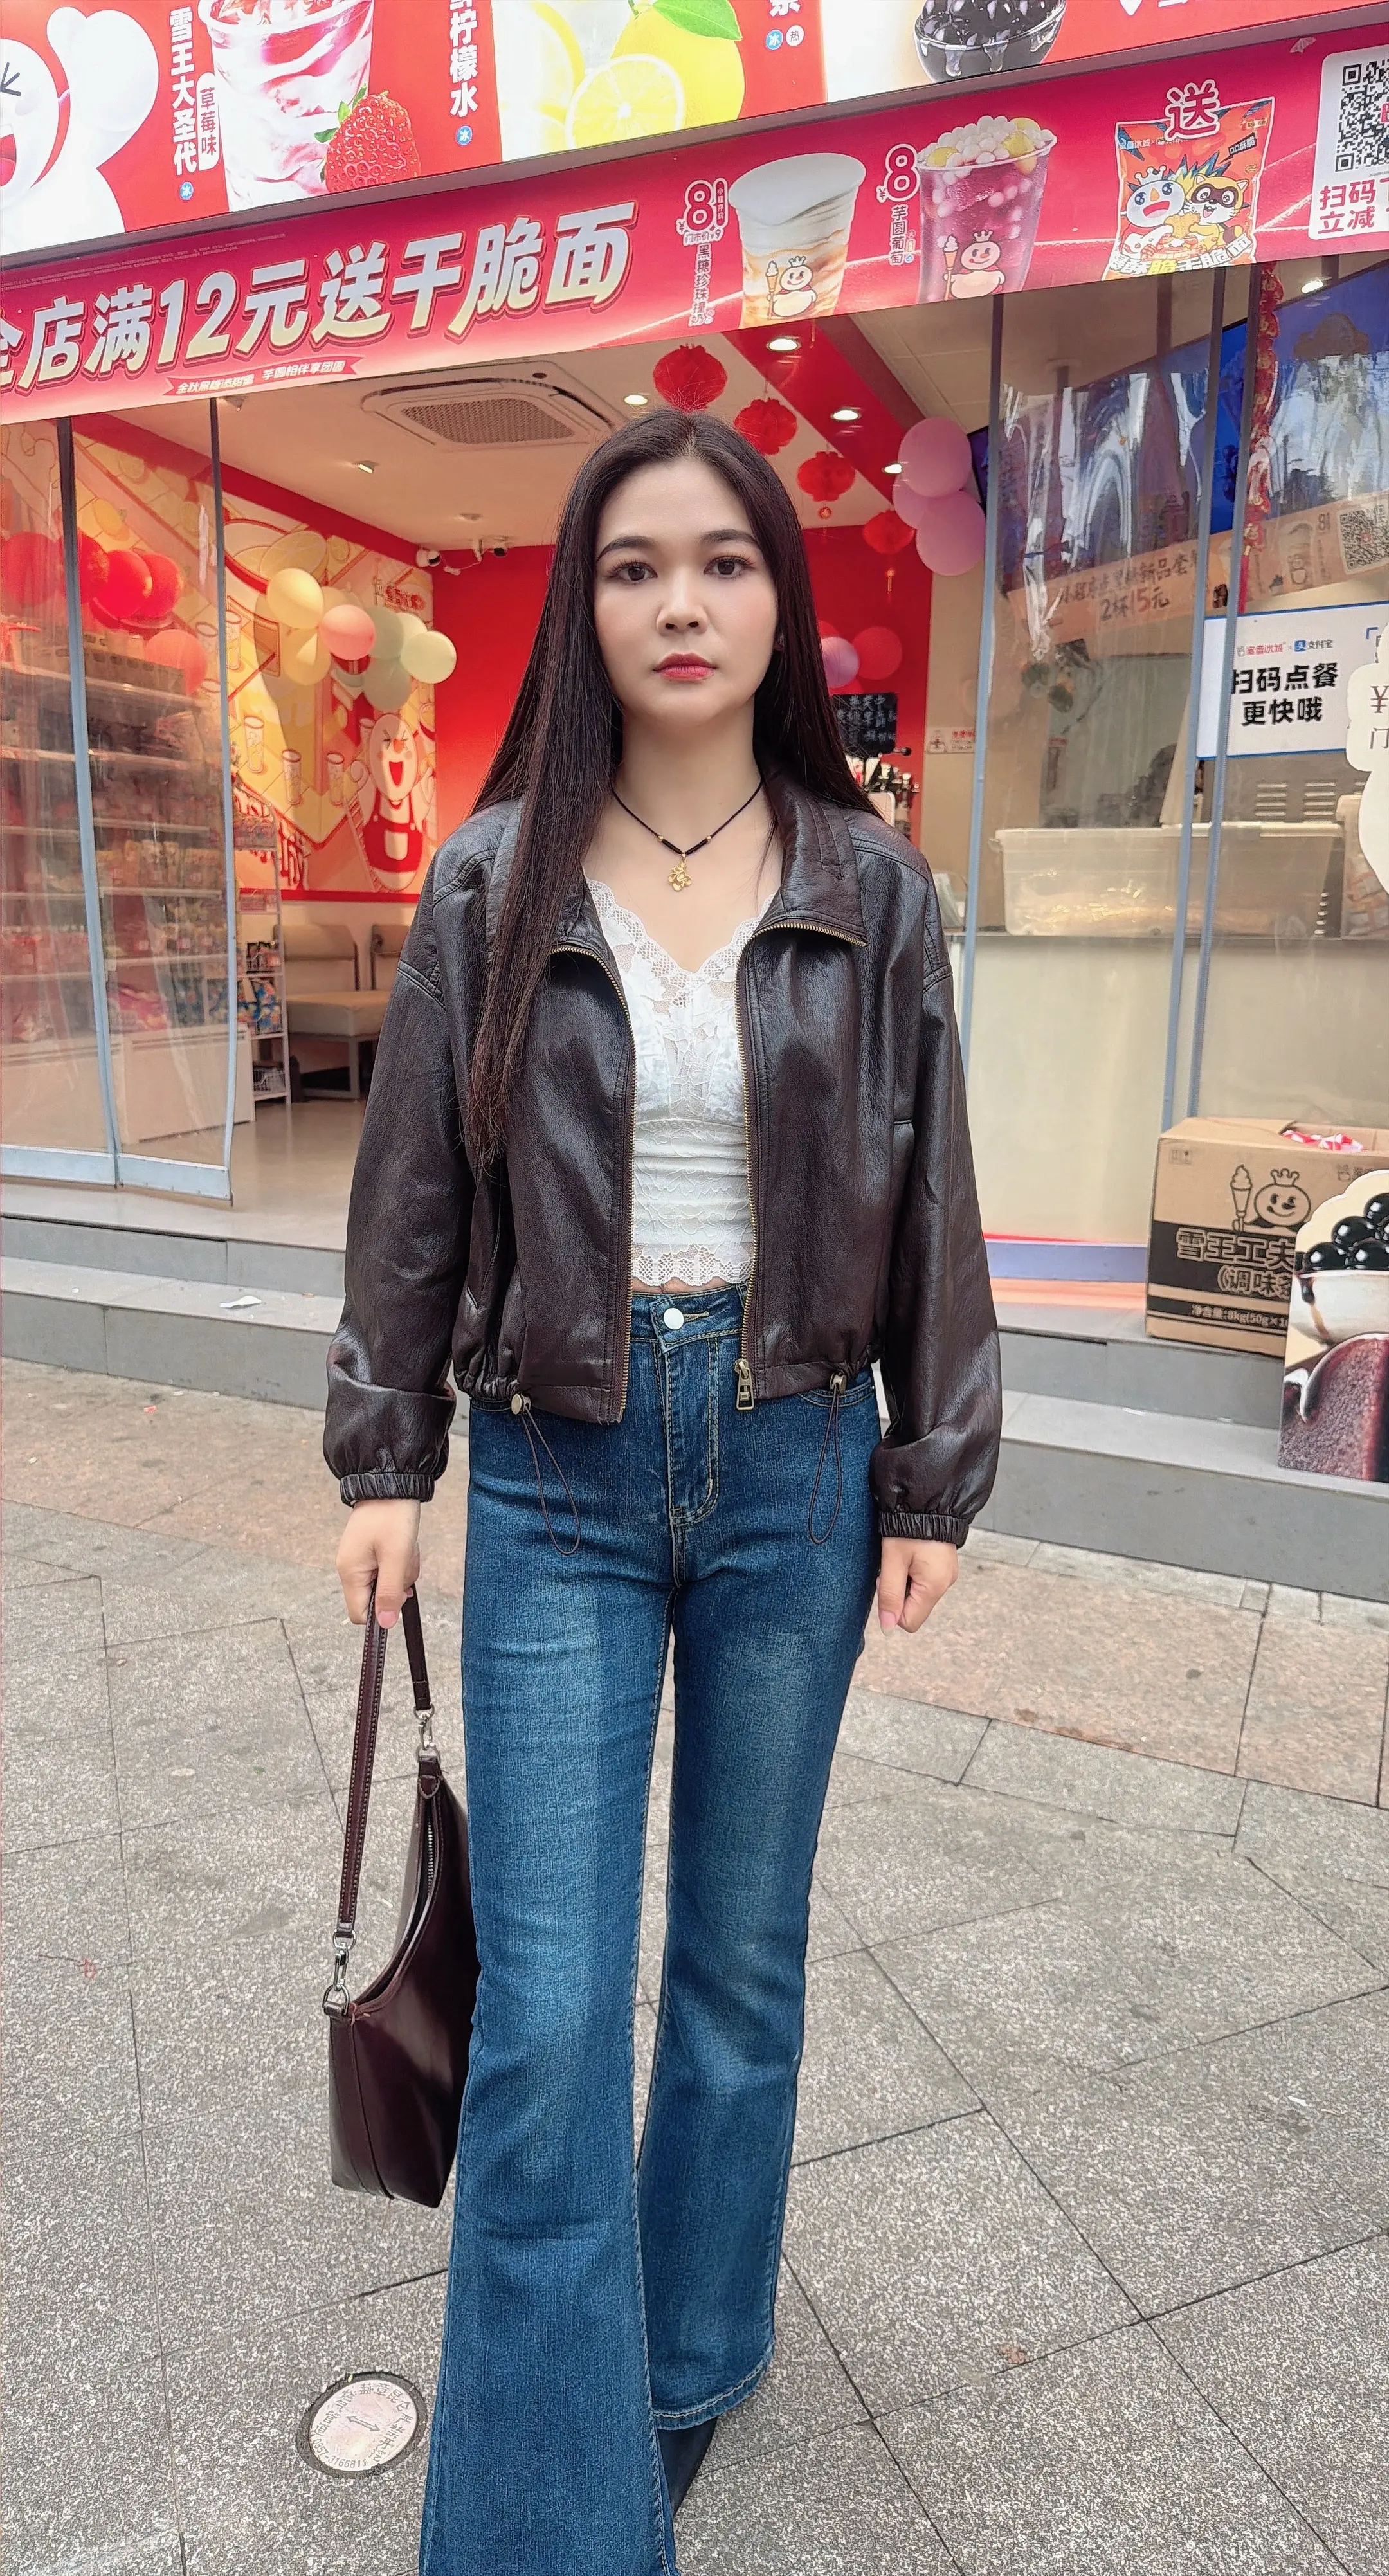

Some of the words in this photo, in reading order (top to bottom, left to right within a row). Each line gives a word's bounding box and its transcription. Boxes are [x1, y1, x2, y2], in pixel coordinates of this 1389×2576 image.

[449, 0, 478, 118] 柠檬水
[170, 6, 197, 176] 雪王大圣代
[200, 87, 217, 156] 草莓味
[1167, 81, 1216, 138] 送
[1320, 179, 1389, 211] 扫码
[890, 206, 907, 264] 芋圆葡萄
[1318, 205, 1389, 234] 立减
[262, 360, 346, 381] 芋圆相伴享团圆
[1232, 662, 1338, 694] 扫码点餐
[1242, 696, 1323, 727] 更快哦
[359, 2382, 412, 2411] 赫章昆仑
